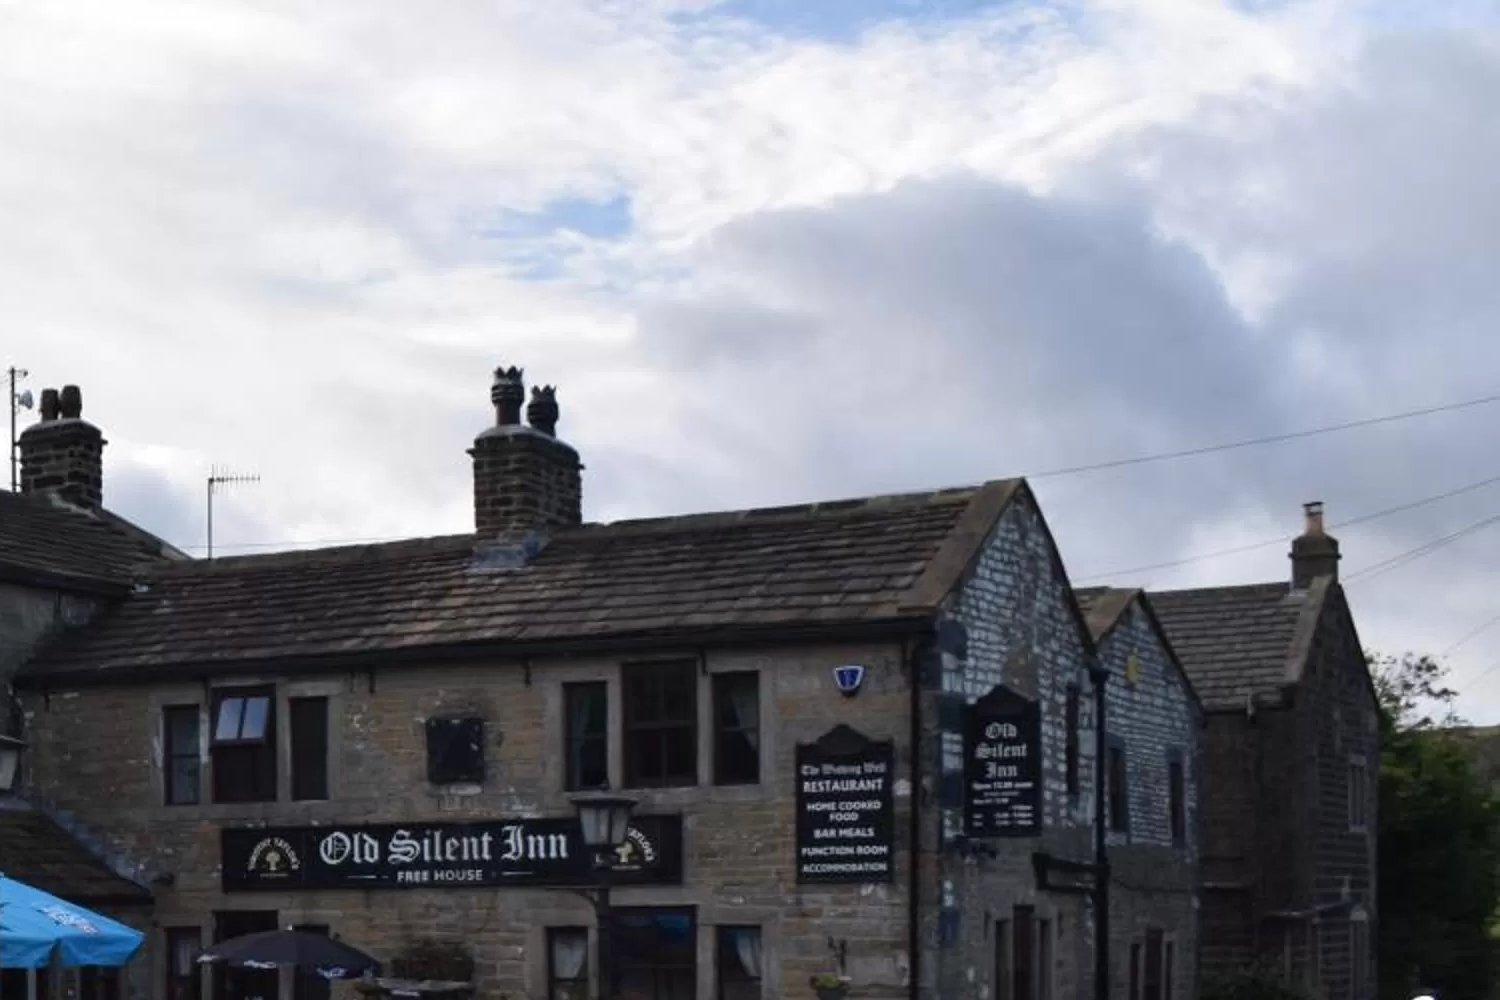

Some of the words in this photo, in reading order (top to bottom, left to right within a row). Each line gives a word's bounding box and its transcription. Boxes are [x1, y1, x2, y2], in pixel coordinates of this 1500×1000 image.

[985, 722, 1017, 739] Old
[975, 742, 1028, 759] Silent
[985, 763, 1018, 779] Inn
[803, 778, 884, 793] RESTAURANT
[807, 802, 837, 812] HOME
[839, 800, 882, 812] COOKED
[829, 811, 858, 822] FOOD
[814, 828, 836, 838] BAR
[838, 827, 875, 838] MEALS
[320, 832, 378, 864] Old
[387, 829, 492, 864] Silent
[500, 825, 568, 861] Inn
[802, 847, 853, 857] FUNCTION
[856, 845, 888, 857] ROOM
[396, 871, 429, 882] FREE
[434, 869, 483, 881] HOUSE
